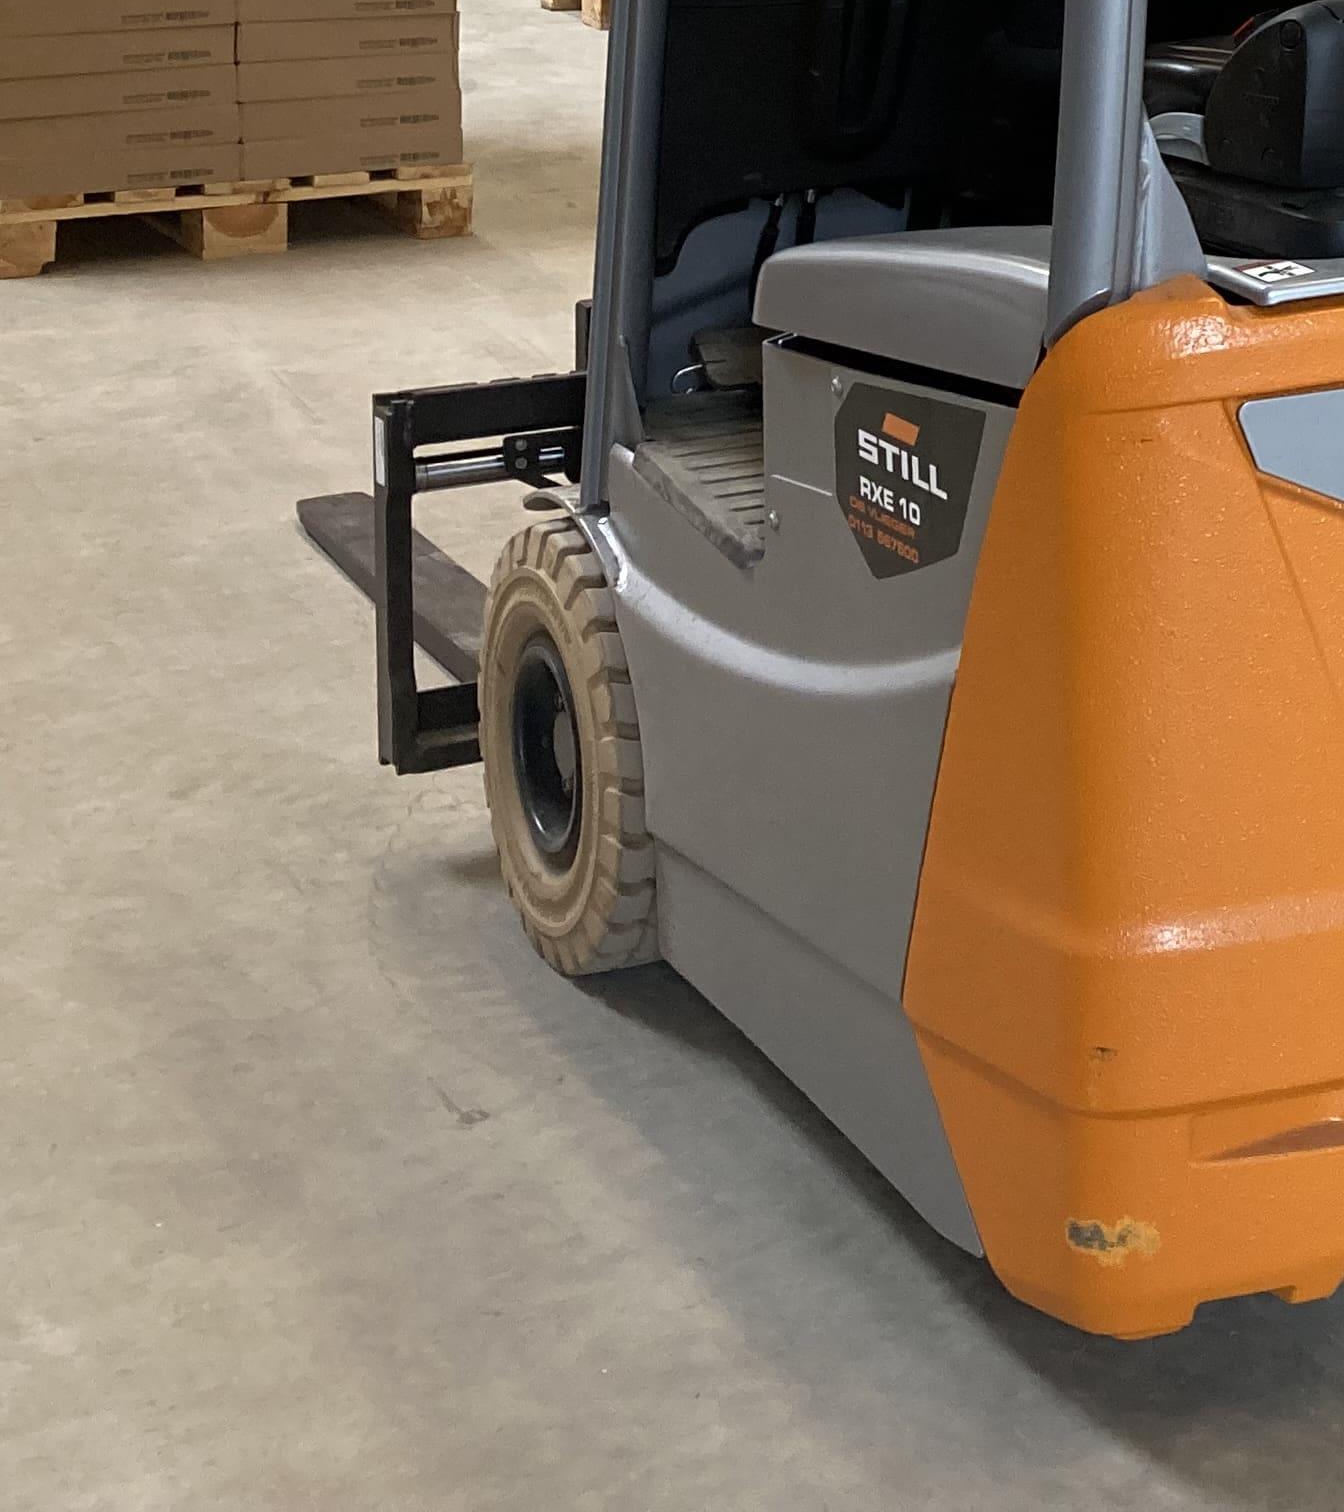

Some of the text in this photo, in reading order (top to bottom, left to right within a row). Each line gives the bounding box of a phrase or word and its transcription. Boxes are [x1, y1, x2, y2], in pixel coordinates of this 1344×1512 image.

[857, 428, 948, 501] STILL
[859, 474, 921, 527] RXE 10
